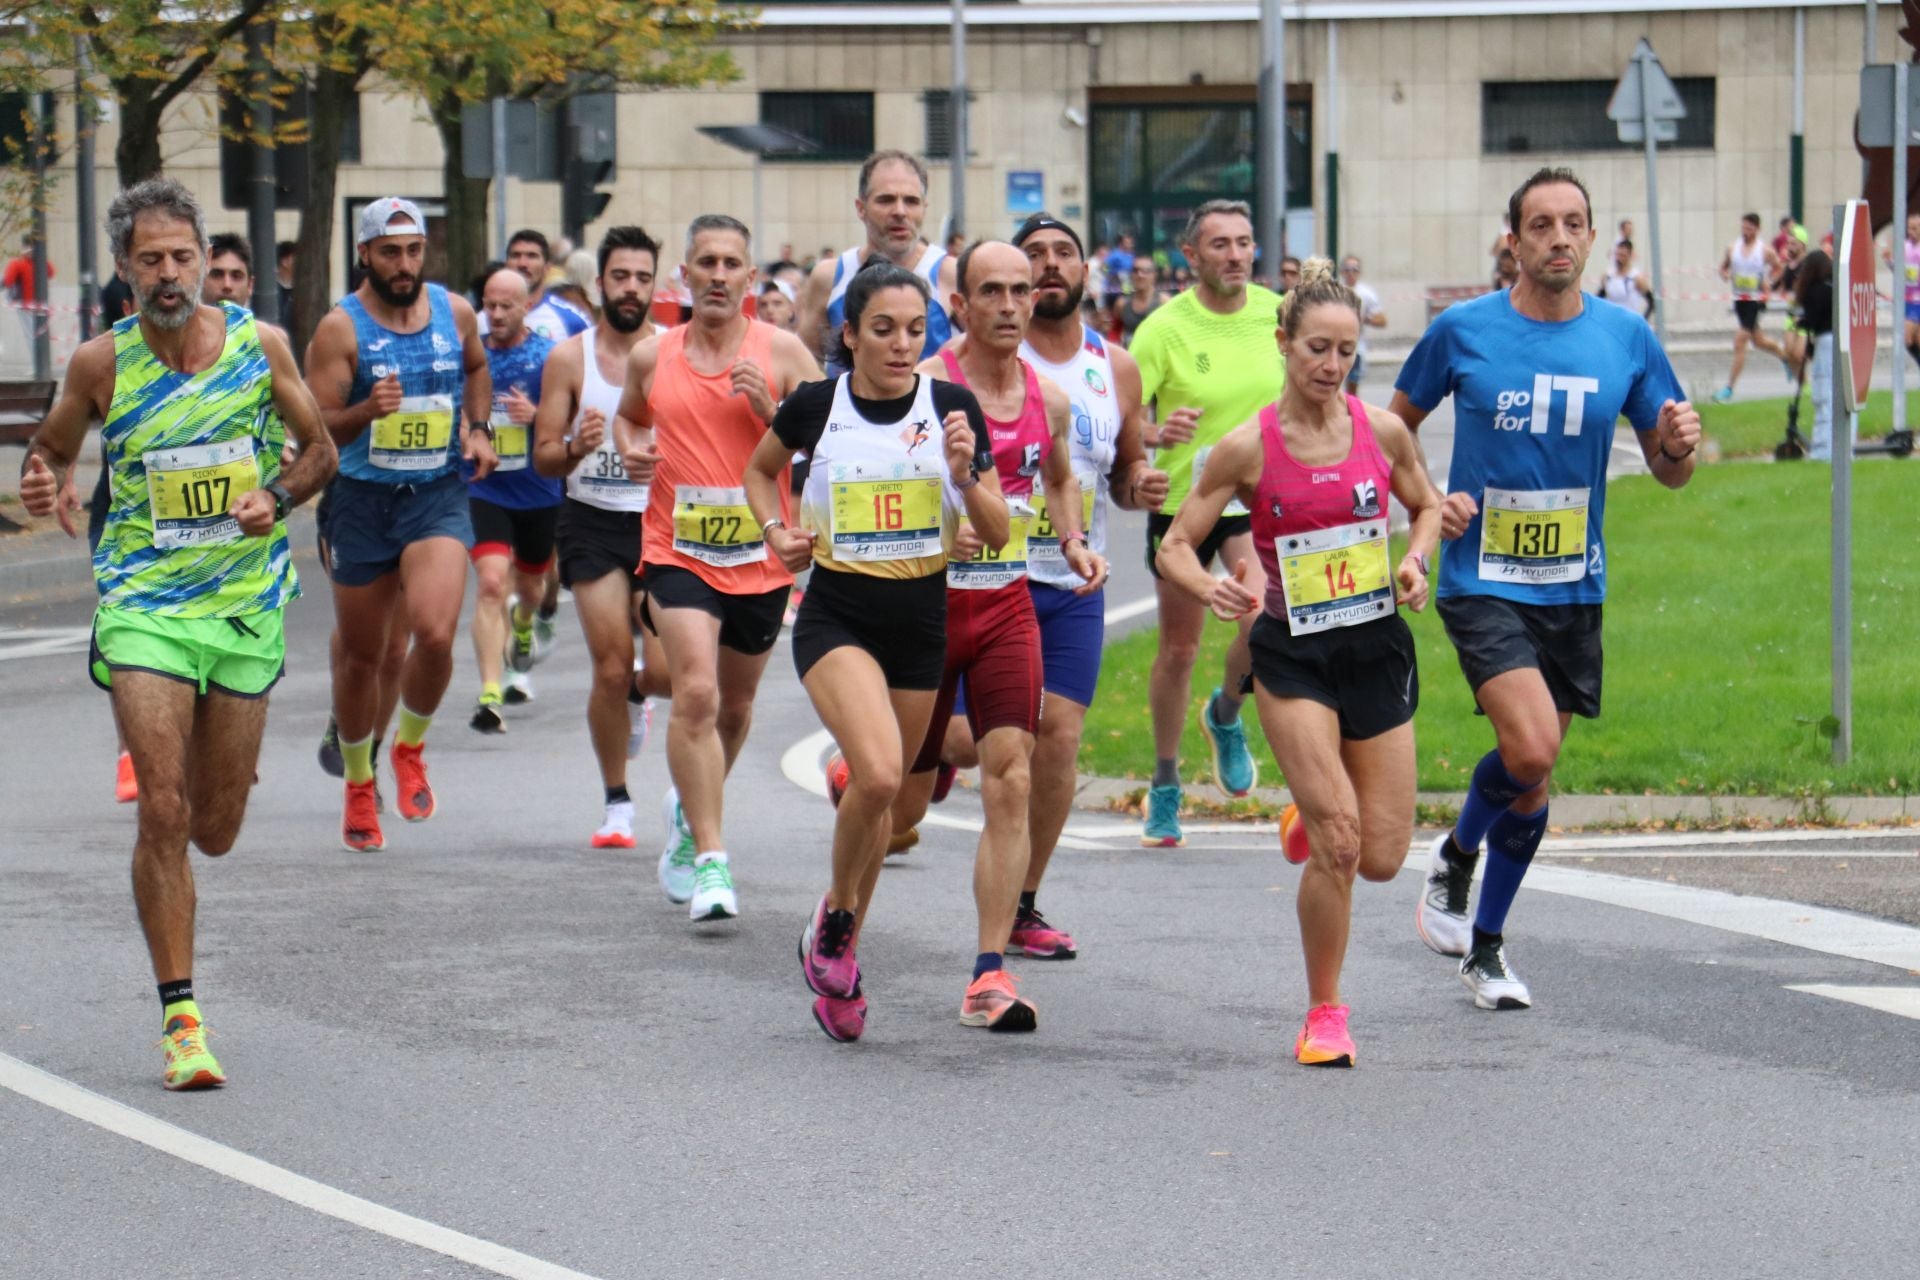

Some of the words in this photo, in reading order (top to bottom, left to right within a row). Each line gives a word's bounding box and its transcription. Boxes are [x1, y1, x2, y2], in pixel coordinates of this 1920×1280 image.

[1852, 282, 1875, 328] STOP
[1497, 389, 1531, 411] go
[1530, 373, 1599, 436] IT
[1494, 411, 1531, 432] for
[400, 422, 428, 448] 59
[192, 468, 218, 480] RICKY
[597, 451, 623, 478] 38
[181, 476, 231, 517] 107
[872, 483, 904, 493] LORETO
[873, 493, 903, 531] 16
[198, 520, 240, 539] HYUNDA
[700, 516, 741, 545] 122
[1513, 522, 1561, 556] 130
[876, 541, 925, 553] HYUNDAI
[1324, 550, 1350, 562] LAURA
[971, 573, 1014, 583] HYUNDAI
[1324, 560, 1357, 598] 14
[1521, 565, 1569, 577] HYUNDAI
[1333, 603, 1377, 621] HYUNDA
